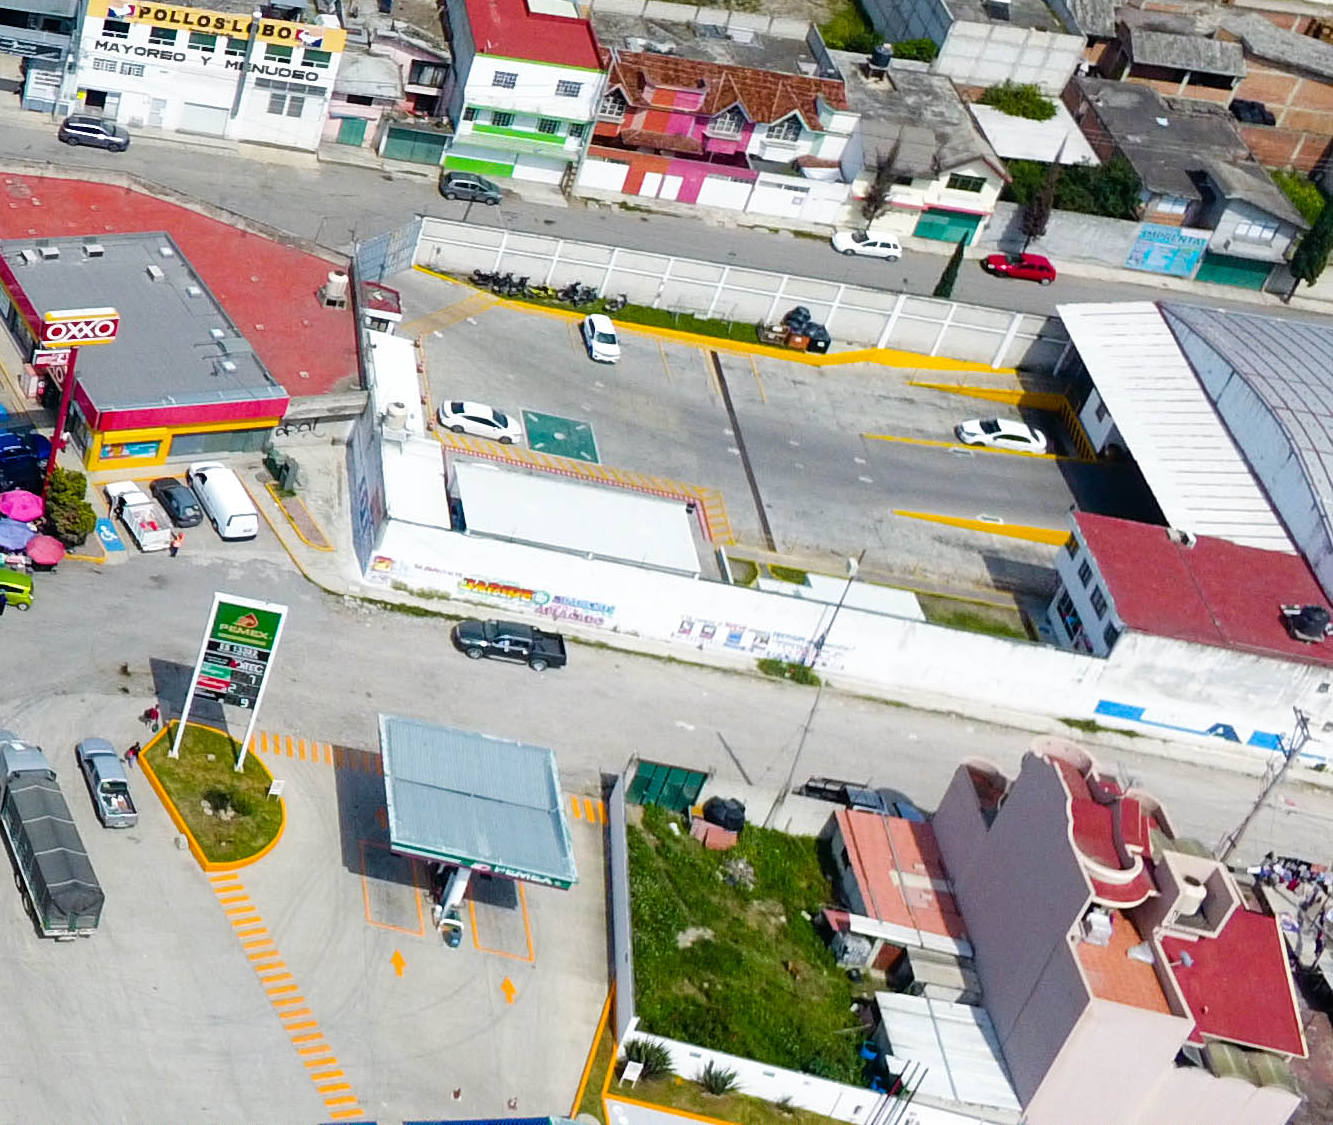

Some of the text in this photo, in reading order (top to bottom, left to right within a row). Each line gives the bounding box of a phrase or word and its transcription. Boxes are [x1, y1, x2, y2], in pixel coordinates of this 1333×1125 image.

[138, 6, 225, 29] POLLOS
[231, 19, 292, 39] LOBO
[95, 40, 319, 82] MAYOREO Y MENUDEO
[1141, 228, 1207, 246] IMPRENTA
[46, 319, 116, 342] OXXO
[218, 622, 270, 640] PEMEX
